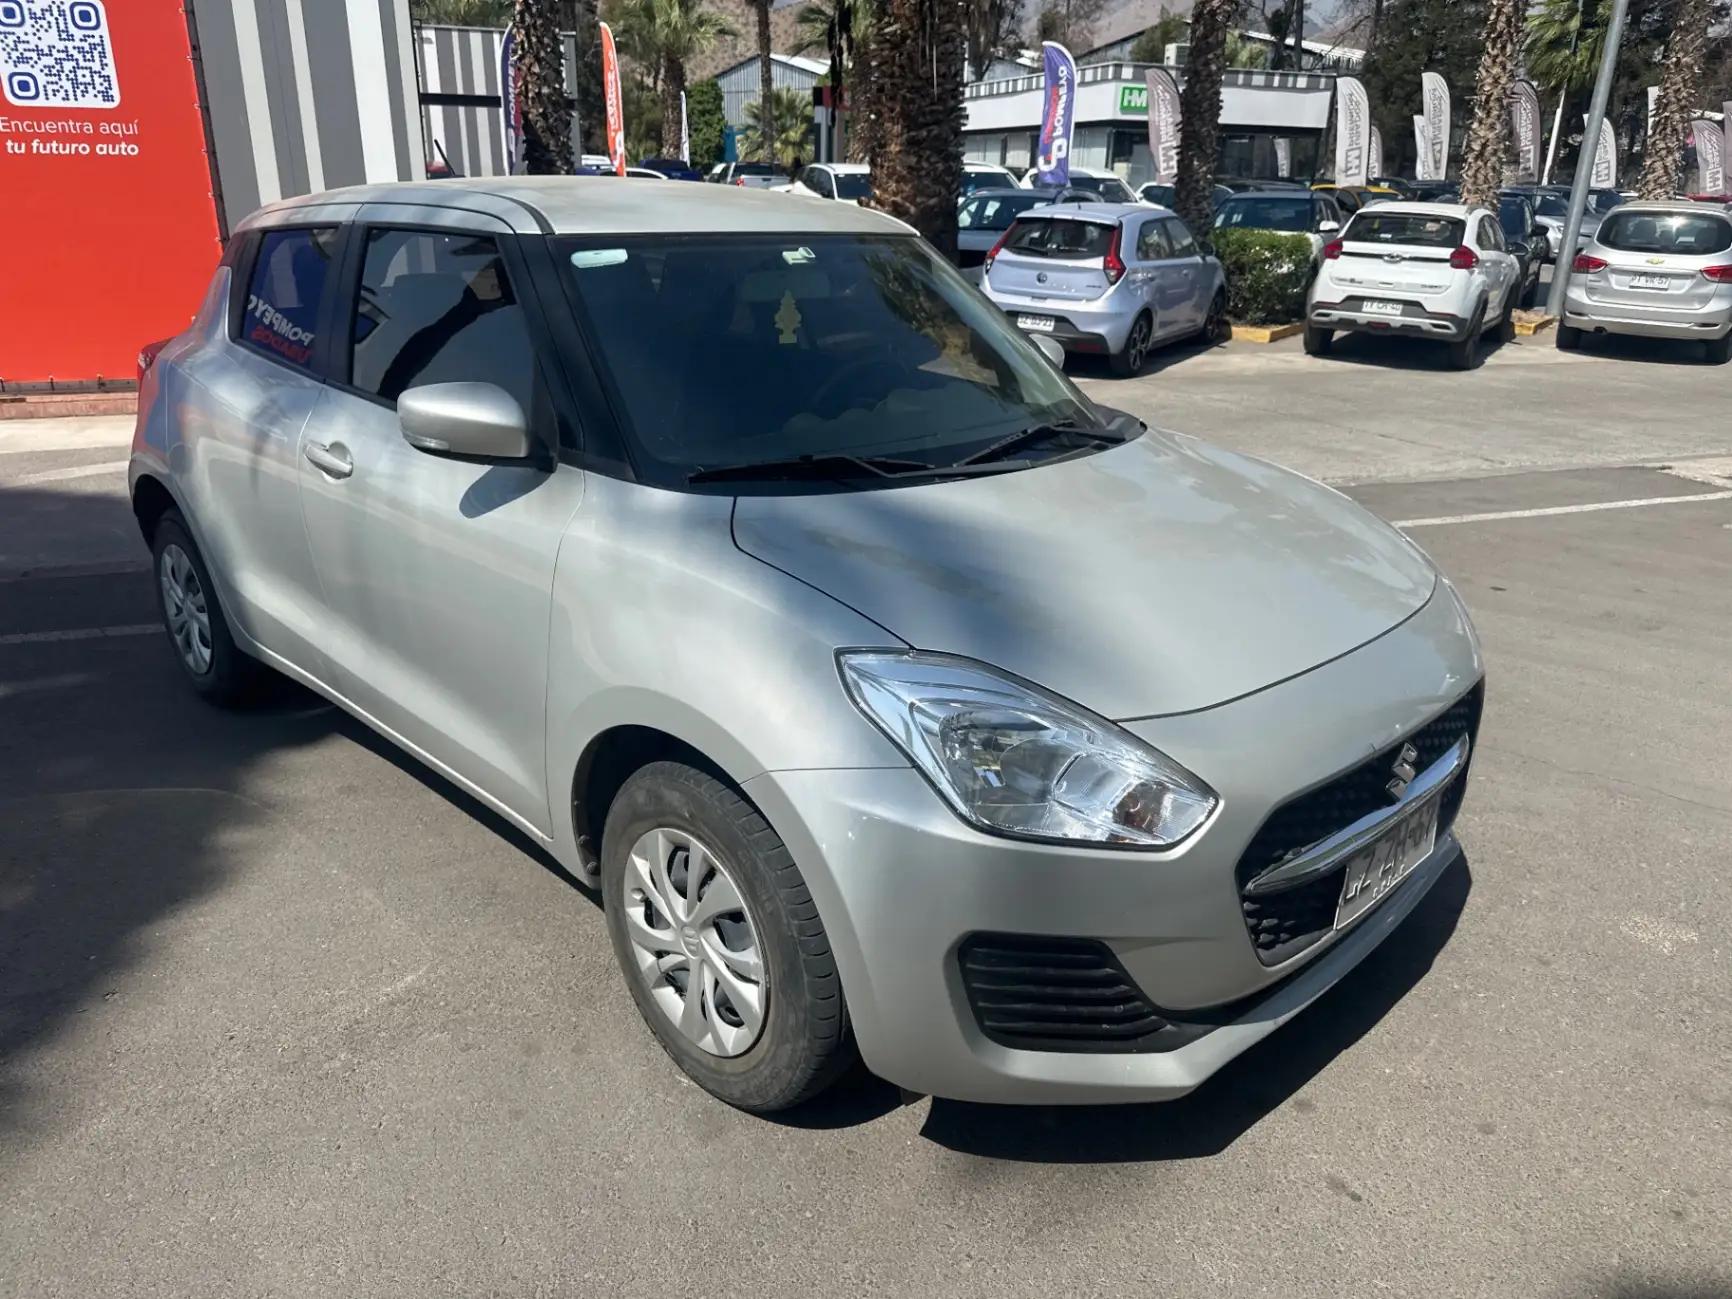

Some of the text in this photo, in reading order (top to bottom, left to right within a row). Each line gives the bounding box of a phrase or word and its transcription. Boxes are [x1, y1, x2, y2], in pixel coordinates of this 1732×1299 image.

[1123, 88, 1148, 108] HM
[0, 117, 139, 137] Encuentra aquí
[6, 139, 139, 156] tu futuro auto
